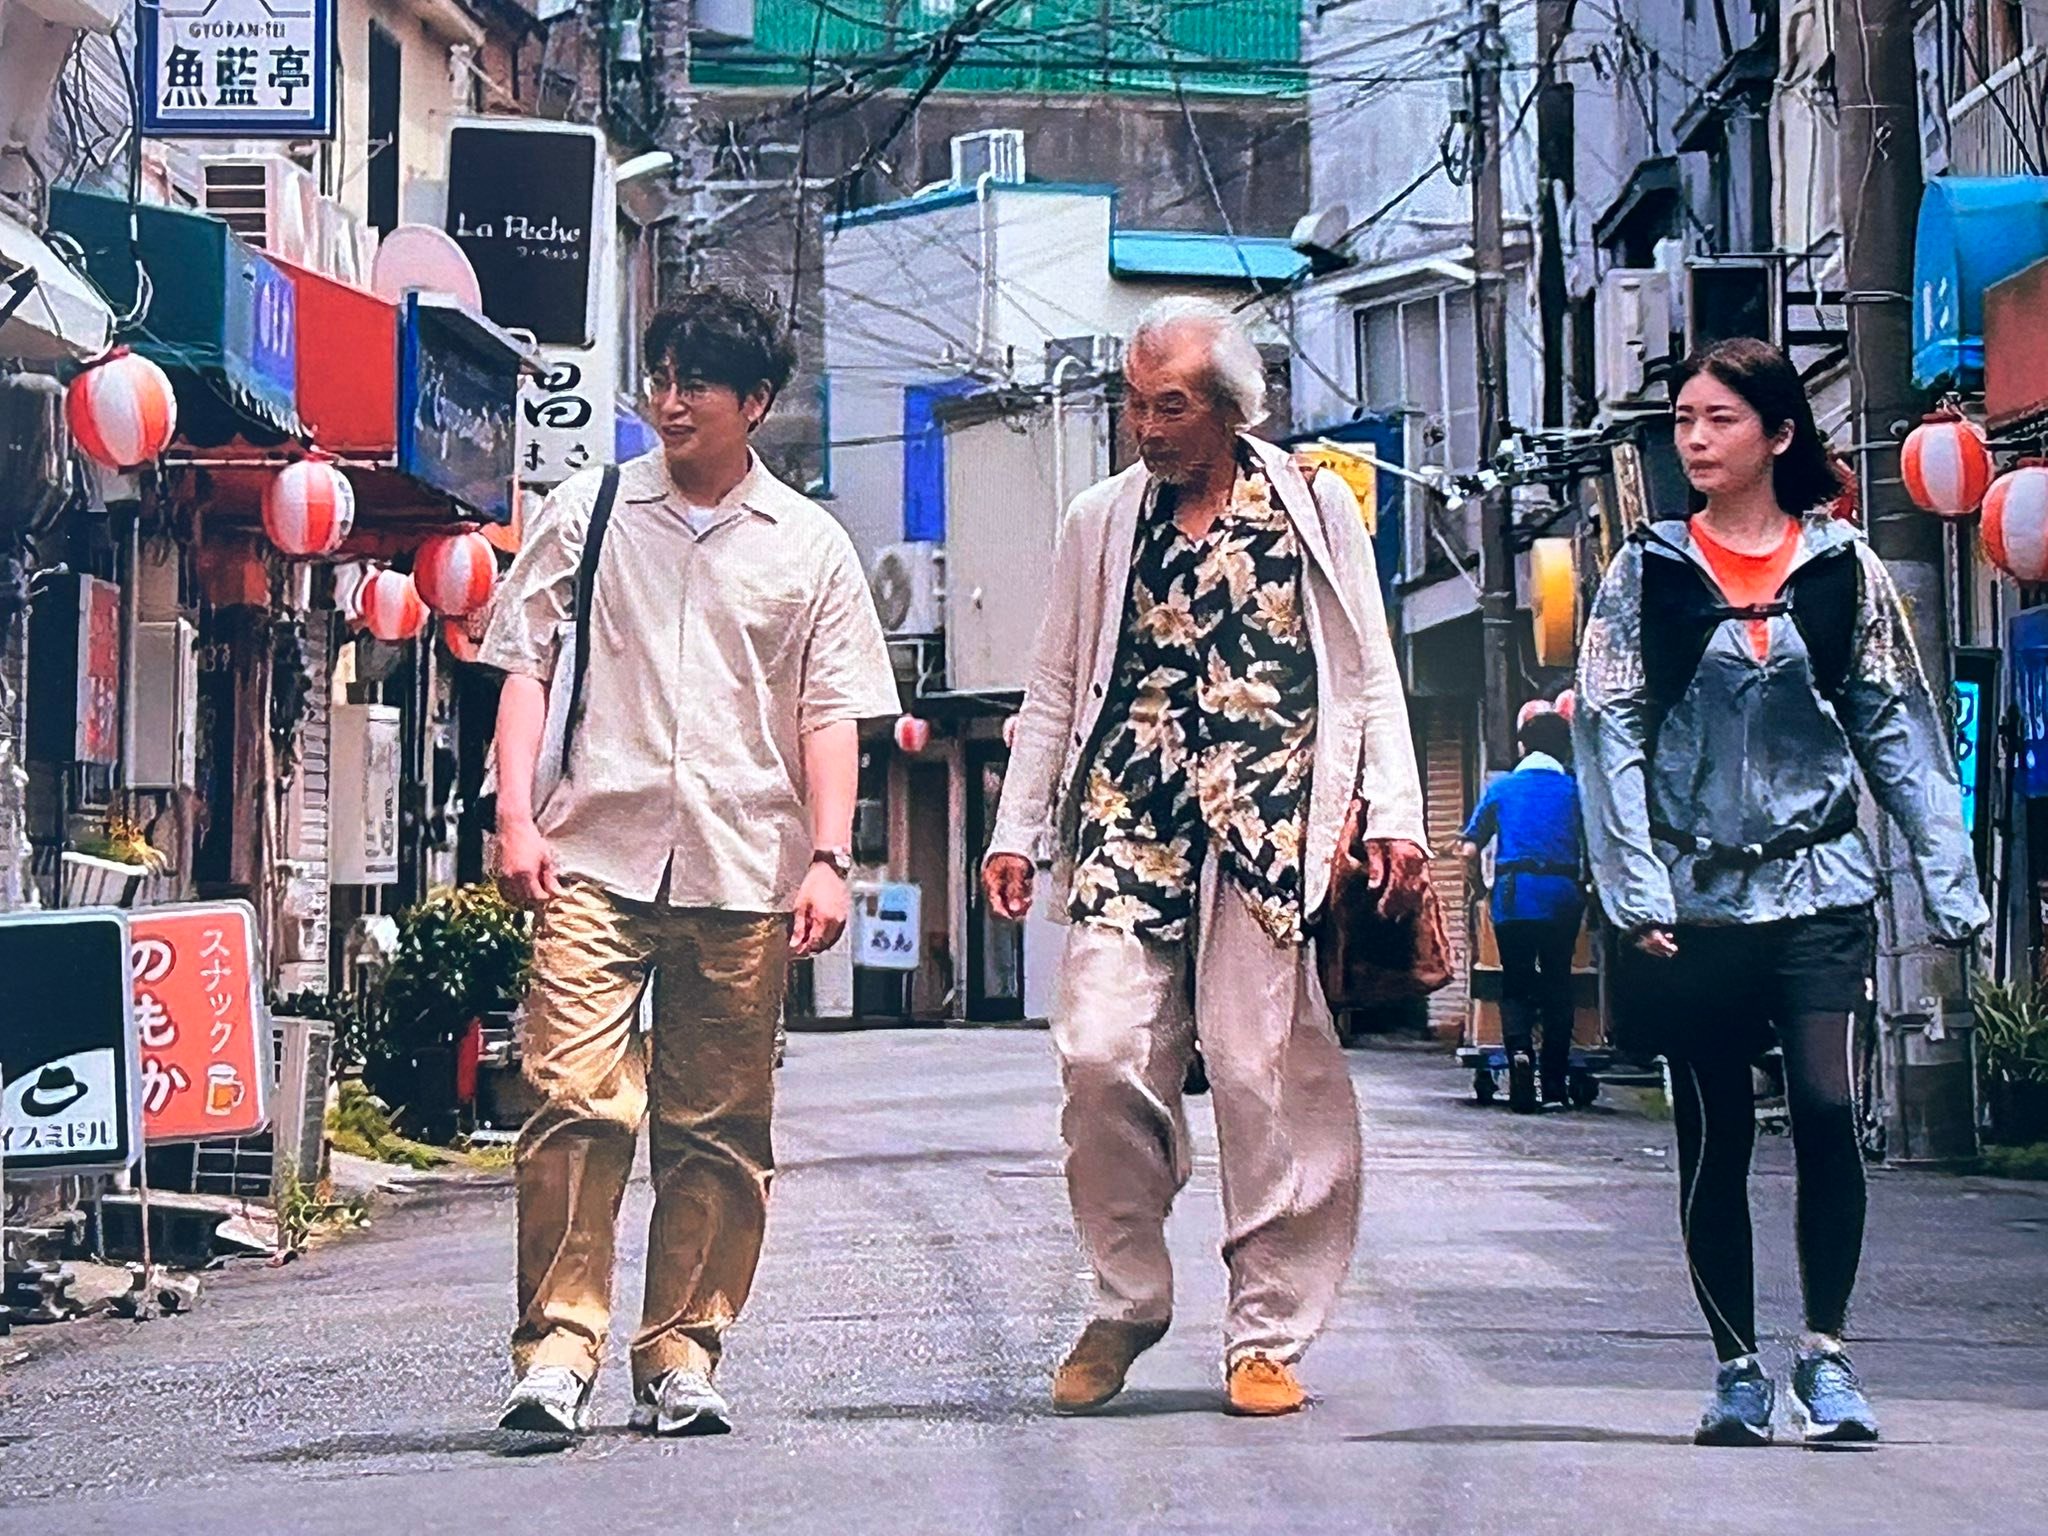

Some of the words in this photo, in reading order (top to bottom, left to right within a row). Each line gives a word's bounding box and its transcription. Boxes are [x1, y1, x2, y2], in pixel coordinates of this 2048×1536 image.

[162, 45, 310, 106] 魚藍亭
[456, 212, 493, 237] La
[523, 439, 590, 471] まさ
[200, 930, 233, 1054] スナック
[131, 936, 191, 1116] のもか
